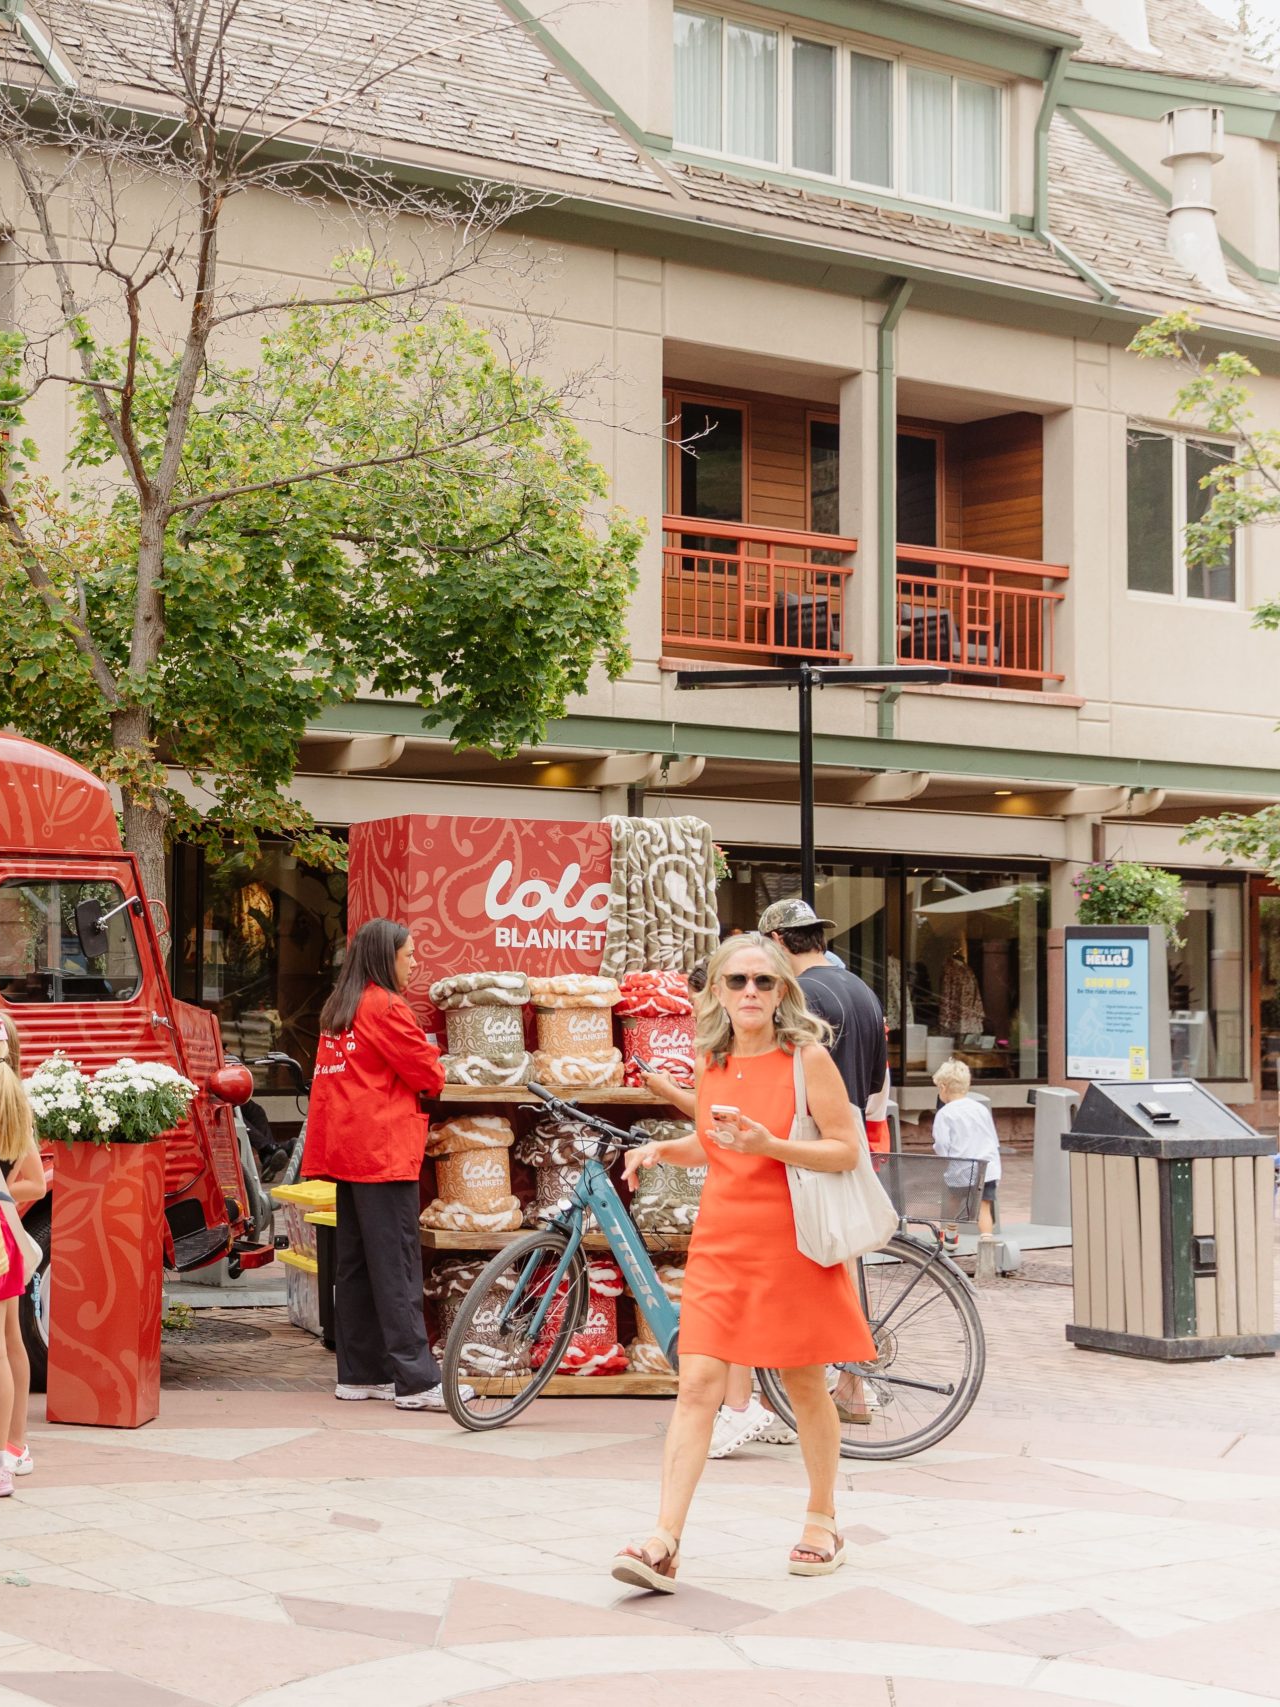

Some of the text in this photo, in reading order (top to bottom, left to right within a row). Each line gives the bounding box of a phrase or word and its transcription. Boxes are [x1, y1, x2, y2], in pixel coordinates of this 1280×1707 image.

[495, 927, 607, 951] BLANKET
[483, 1016, 520, 1036] lola
[568, 1014, 609, 1034] lola
[487, 1034, 521, 1043] BLANKETS
[572, 1033, 608, 1042] BLANKETS
[649, 1028, 692, 1048] lola
[462, 1159, 506, 1179] lola
[466, 1178, 505, 1188] BLANKETS
[610, 1217, 661, 1310] TREK
